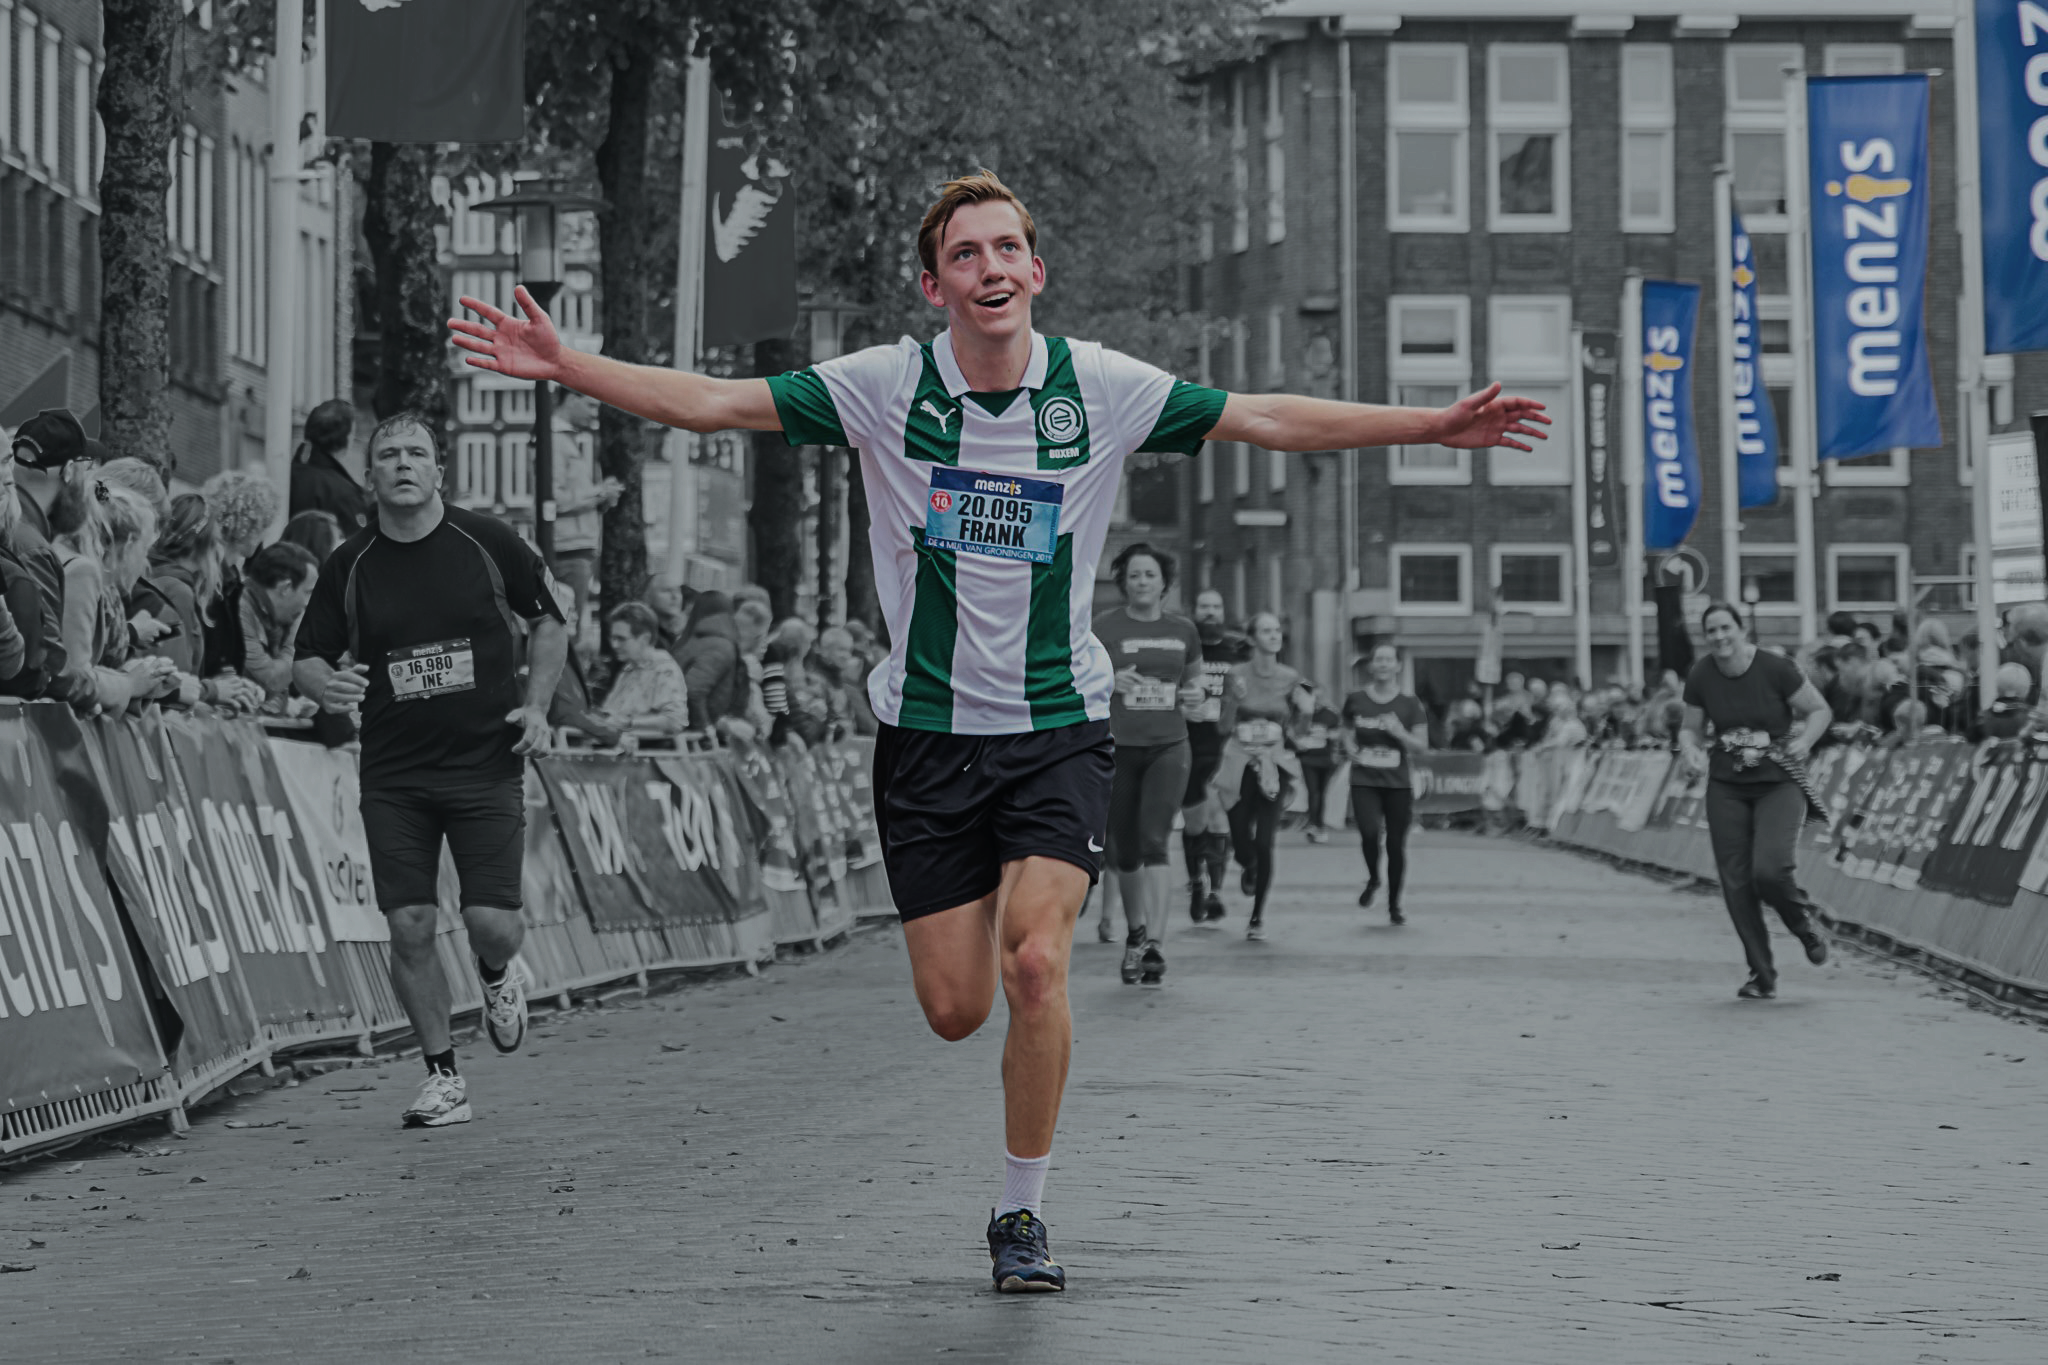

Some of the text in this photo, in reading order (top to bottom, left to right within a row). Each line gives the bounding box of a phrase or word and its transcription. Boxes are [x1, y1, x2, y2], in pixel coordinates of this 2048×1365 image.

[1824, 137, 1913, 397] menzis
[1643, 325, 1689, 509] menzis
[1049, 447, 1080, 459] BOXEM
[975, 479, 1022, 496] menzis
[957, 494, 1033, 524] 20.095
[959, 519, 1027, 548] FRANK
[927, 537, 938, 547] DE
[965, 543, 983, 553] VAN
[984, 546, 1034, 559] GRONINGEN
[412, 645, 443, 657] menzis
[407, 655, 453, 676] 16.980
[422, 672, 444, 689] INE
